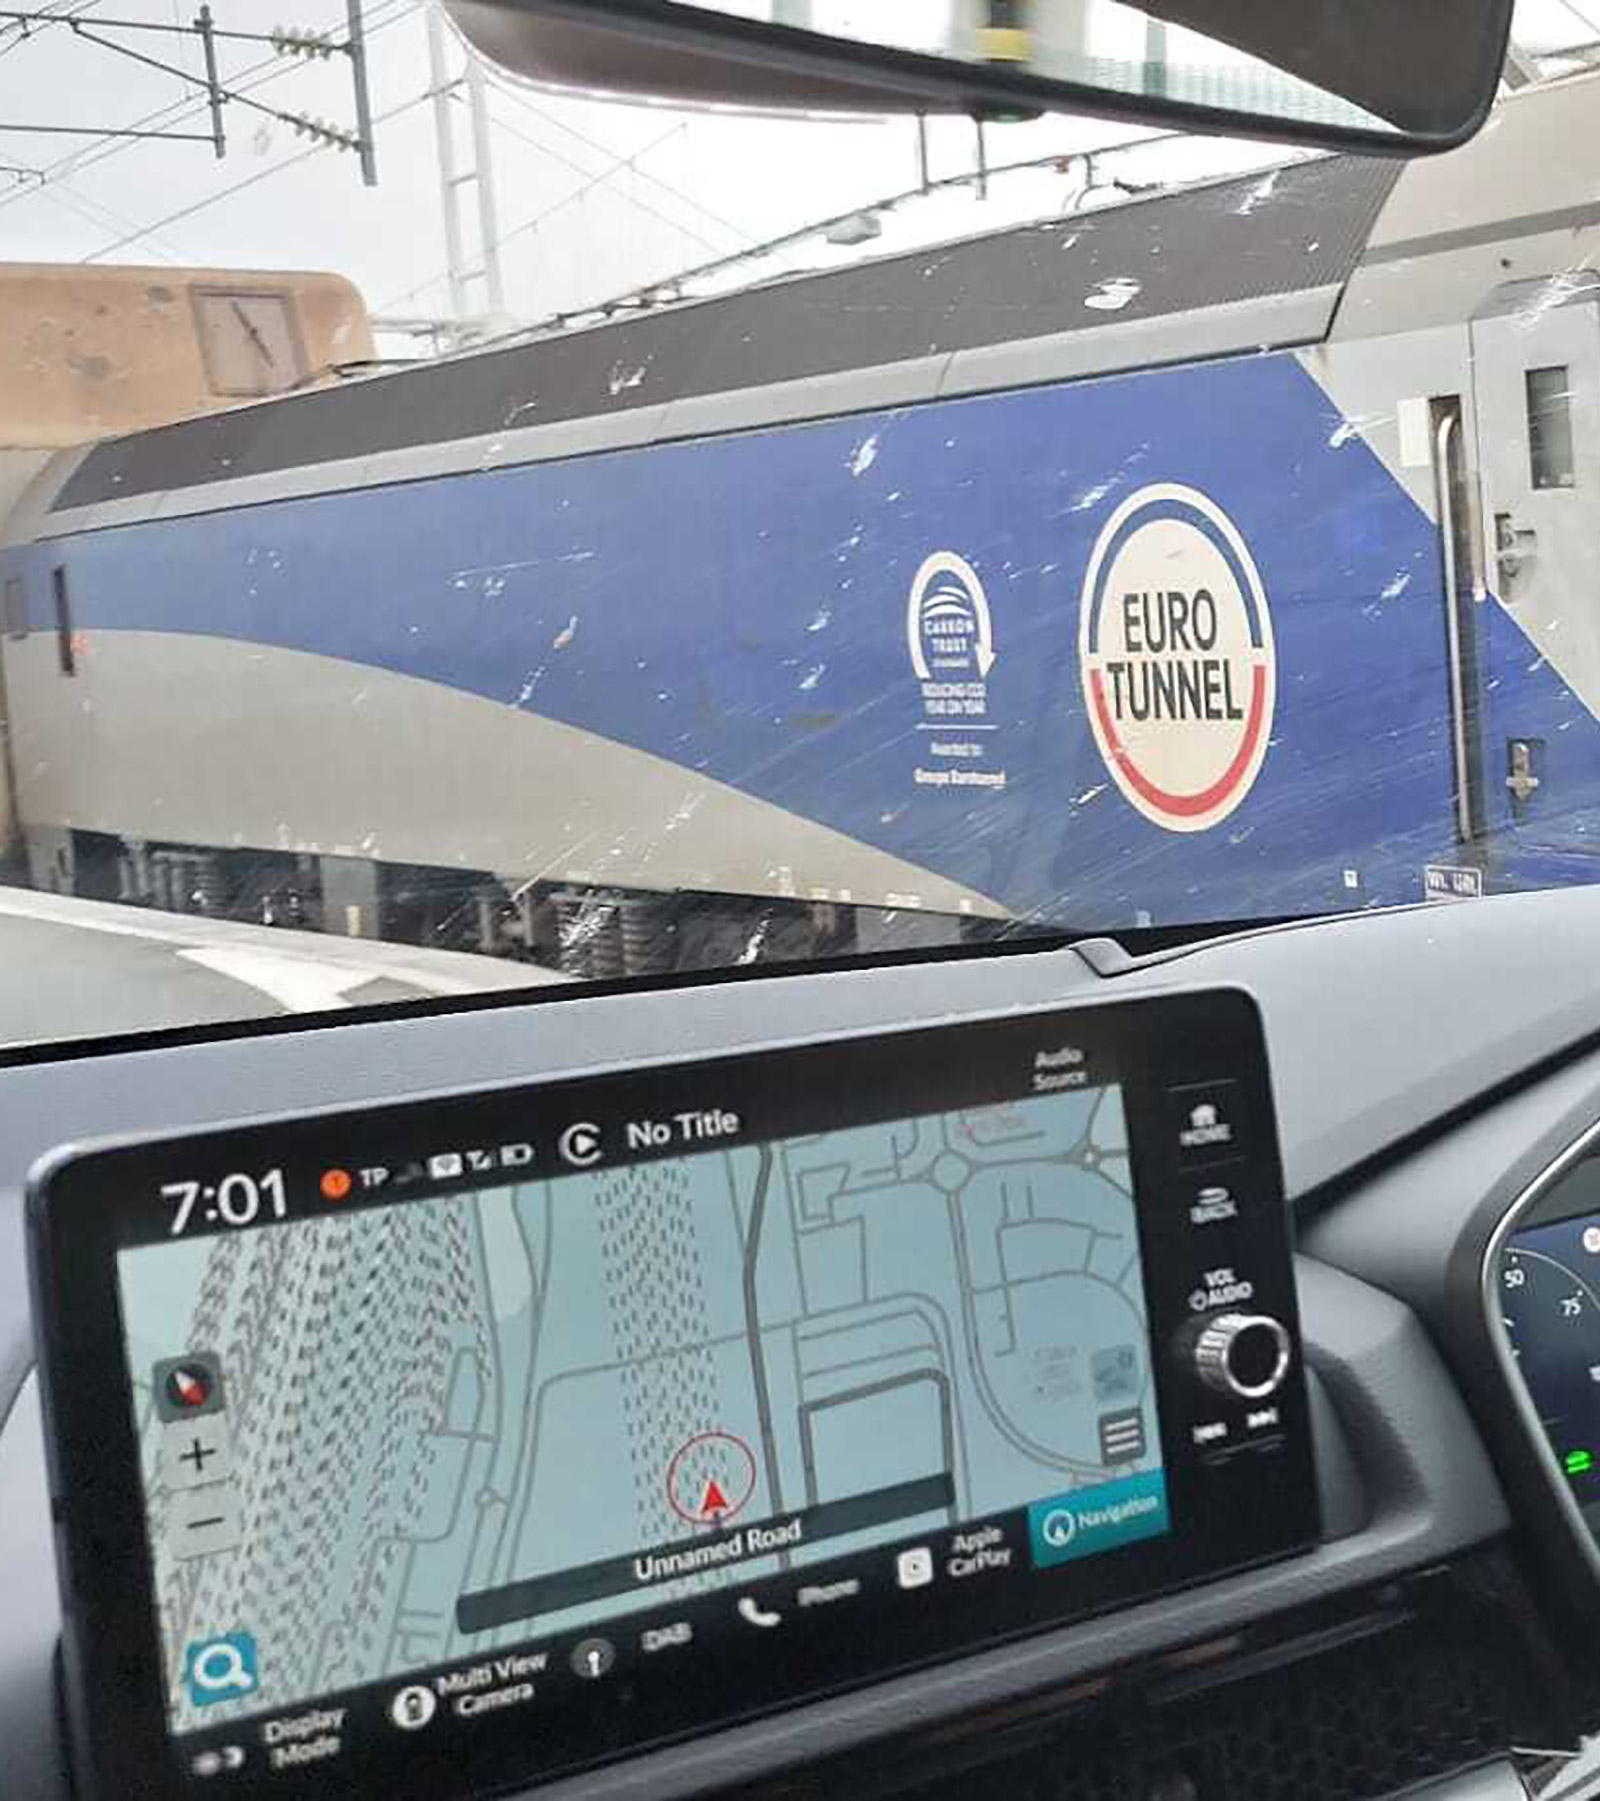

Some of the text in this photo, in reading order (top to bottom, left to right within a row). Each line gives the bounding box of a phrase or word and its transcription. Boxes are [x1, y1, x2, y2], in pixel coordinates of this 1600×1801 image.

[1123, 588, 1218, 653] EURO
[1107, 659, 1244, 722] TUNNEL
[1035, 1047, 1083, 1068] Audio
[1034, 1070, 1087, 1090] Source
[627, 1109, 739, 1149] No Title
[359, 1167, 389, 1187] TP
[160, 1169, 288, 1234] 7:01
[1505, 1269, 1525, 1288] 50
[1560, 1297, 1582, 1316] 75
[1078, 1495, 1159, 1529] Navigation
[634, 1518, 803, 1580] Unnamed Road
[953, 1526, 1004, 1553] Apple
[947, 1548, 1012, 1577] CarPlay
[437, 1652, 548, 1696] Multi View
[457, 1682, 533, 1715] Camera
[265, 1707, 344, 1743] Display
[274, 1736, 341, 1767] Mode
